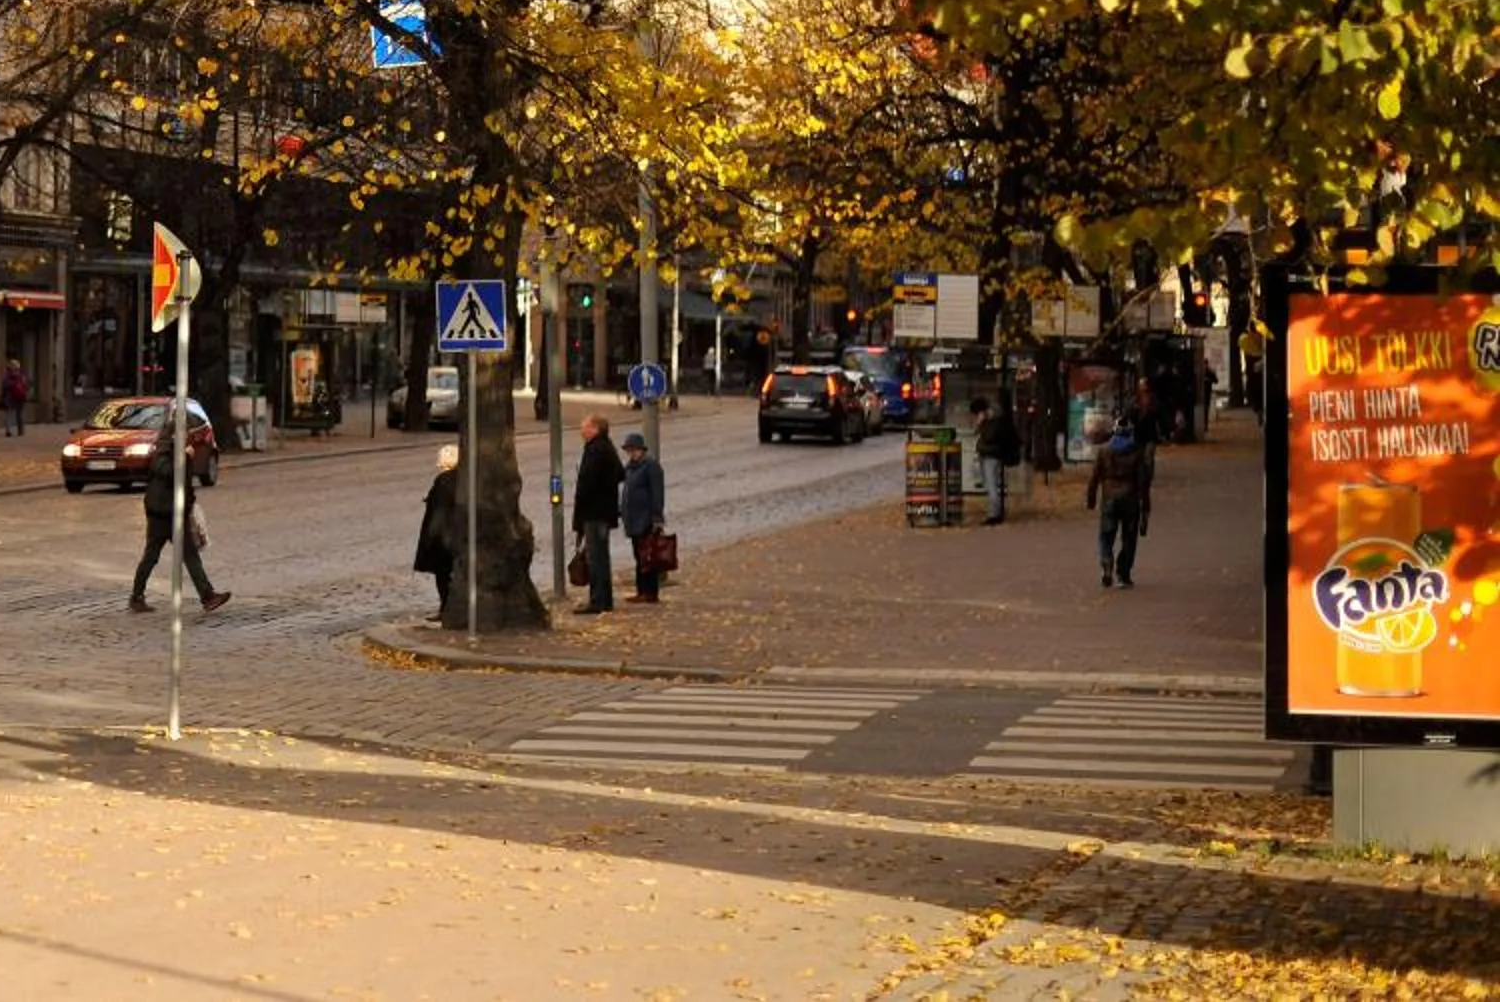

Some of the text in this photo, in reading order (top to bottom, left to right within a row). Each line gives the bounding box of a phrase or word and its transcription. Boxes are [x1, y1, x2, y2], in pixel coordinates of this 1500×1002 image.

[1305, 329, 1453, 375] UUSI TÖLKKI
[1309, 384, 1422, 423] PIENI HINTA
[1312, 421, 1470, 462] ISOSTI HAUSKAA!
[1314, 561, 1446, 629] Fanta
